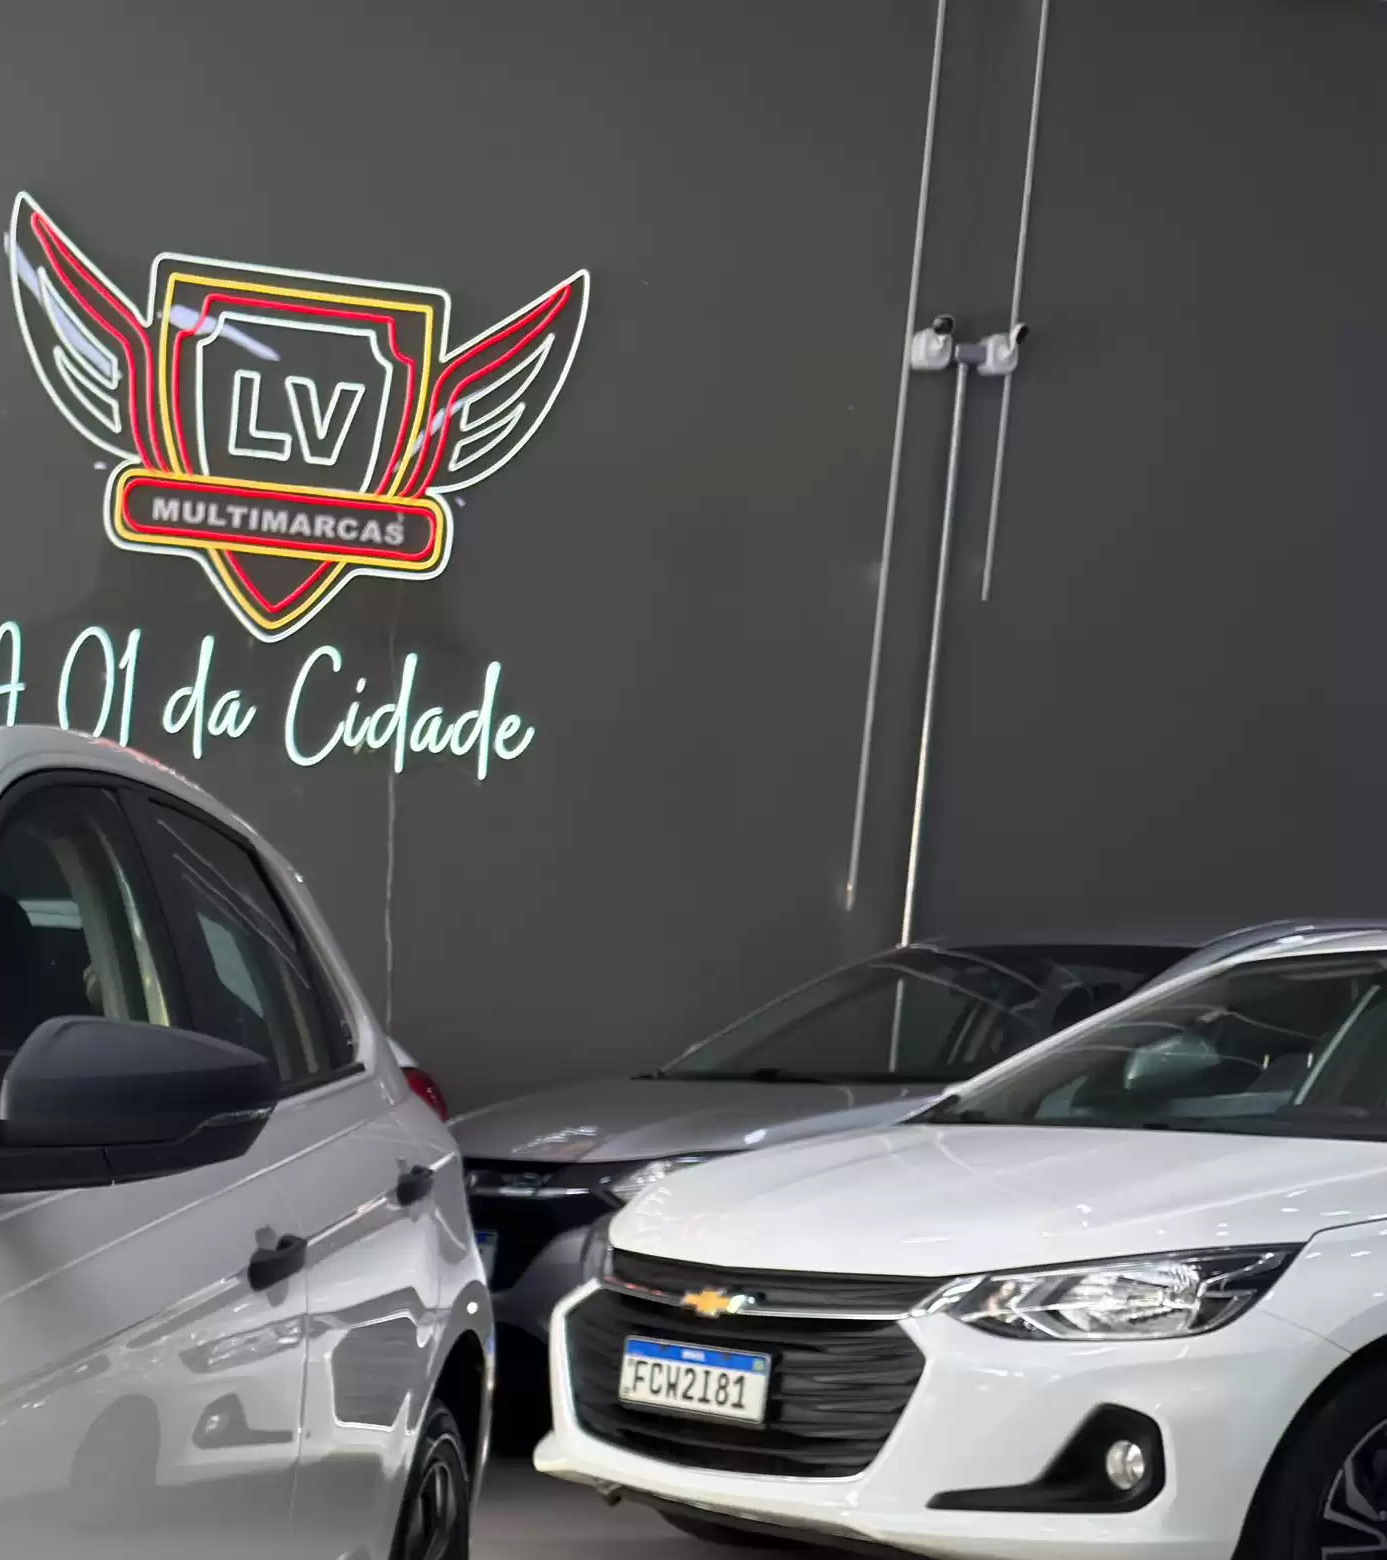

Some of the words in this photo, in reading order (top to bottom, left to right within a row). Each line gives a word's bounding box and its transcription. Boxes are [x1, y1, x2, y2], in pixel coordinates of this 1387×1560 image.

[228, 369, 365, 465] LV
[151, 497, 406, 546] MULTIMARCAS
[162, 636, 256, 759] da
[284, 645, 535, 780] Cidade
[632, 1360, 747, 1409] FCW2I81
